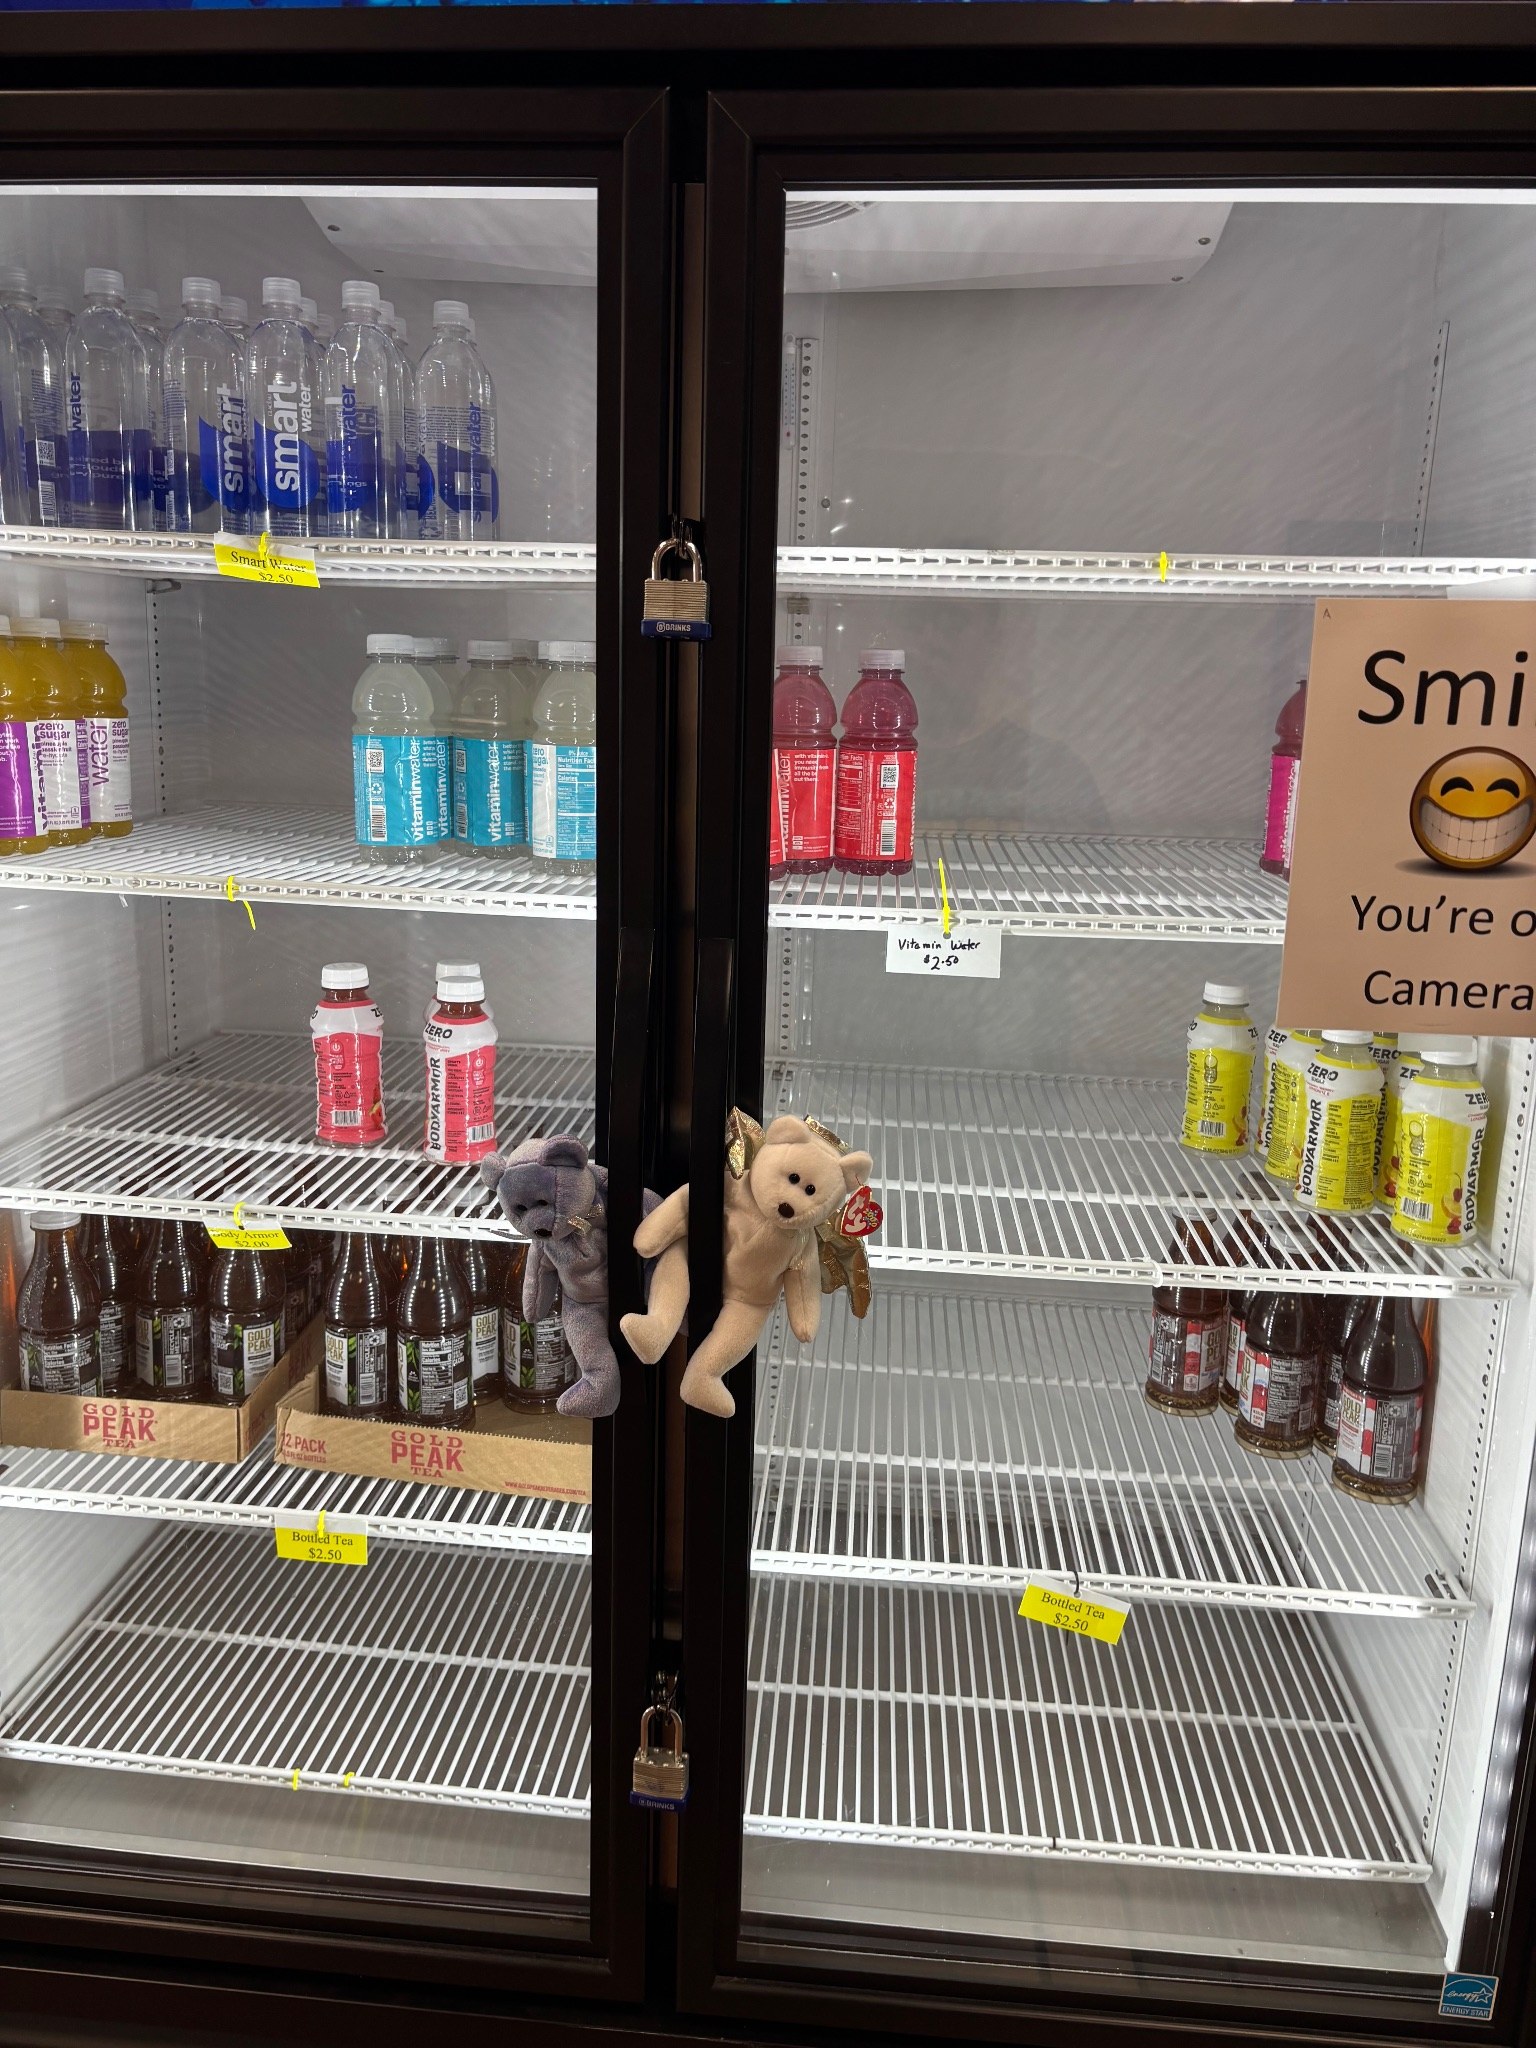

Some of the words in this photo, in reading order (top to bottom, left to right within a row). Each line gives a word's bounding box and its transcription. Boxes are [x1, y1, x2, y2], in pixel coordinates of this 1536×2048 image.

[70, 371, 81, 431] water
[299, 384, 312, 432] water
[217, 383, 244, 492] smart
[268, 378, 298, 491] smart
[230, 550, 267, 569] Smart
[258, 571, 294, 584] $2.50
[39, 722, 64, 730] zero
[112, 721, 127, 729] zero
[39, 730, 71, 740] sugar
[89, 720, 110, 787] water
[410, 736, 424, 842] vitaminwater
[437, 739, 449, 837] vitaminwater
[486, 741, 501, 842] vitaminwater
[1350, 895, 1494, 936] You're
[898, 938, 942, 951] Vitamin
[950, 938, 981, 951] Water
[923, 954, 960, 971] $2.50
[1364, 969, 1535, 1011] Camera
[424, 1022, 453, 1039] ZERO
[1307, 1062, 1339, 1082] ZERO
[430, 1056, 441, 1151] BODYARMOR
[1301, 1099, 1322, 1196] BODYARMOR
[1463, 1127, 1485, 1232] BODYARMOR
[235, 1240, 270, 1248] $2.00
[244, 1231, 279, 1239] Armor
[476, 1313, 497, 1328] GOLD
[476, 1323, 497, 1337] PEAK
[247, 1327, 271, 1341] GOLD
[247, 1338, 272, 1351] PEAK
[83, 1403, 155, 1419] GOLD
[83, 1414, 156, 1442] PEAK
[103, 1438, 136, 1449] TEA
[294, 1435, 327, 1454] PACK
[391, 1429, 463, 1448] GOLD
[391, 1441, 464, 1472] PEAK
[411, 1466, 444, 1478] TEA
[292, 1531, 330, 1545] Bottled
[333, 1535, 353, 1546] Tea
[308, 1547, 342, 1561] $2.50
[1041, 1591, 1083, 1613] Bottled
[1085, 1604, 1105, 1619] Tea
[1053, 1612, 1089, 1632] $2.50
[1442, 2005, 1470, 2015] ENERGY
[1470, 2009, 1490, 2017] STAR
